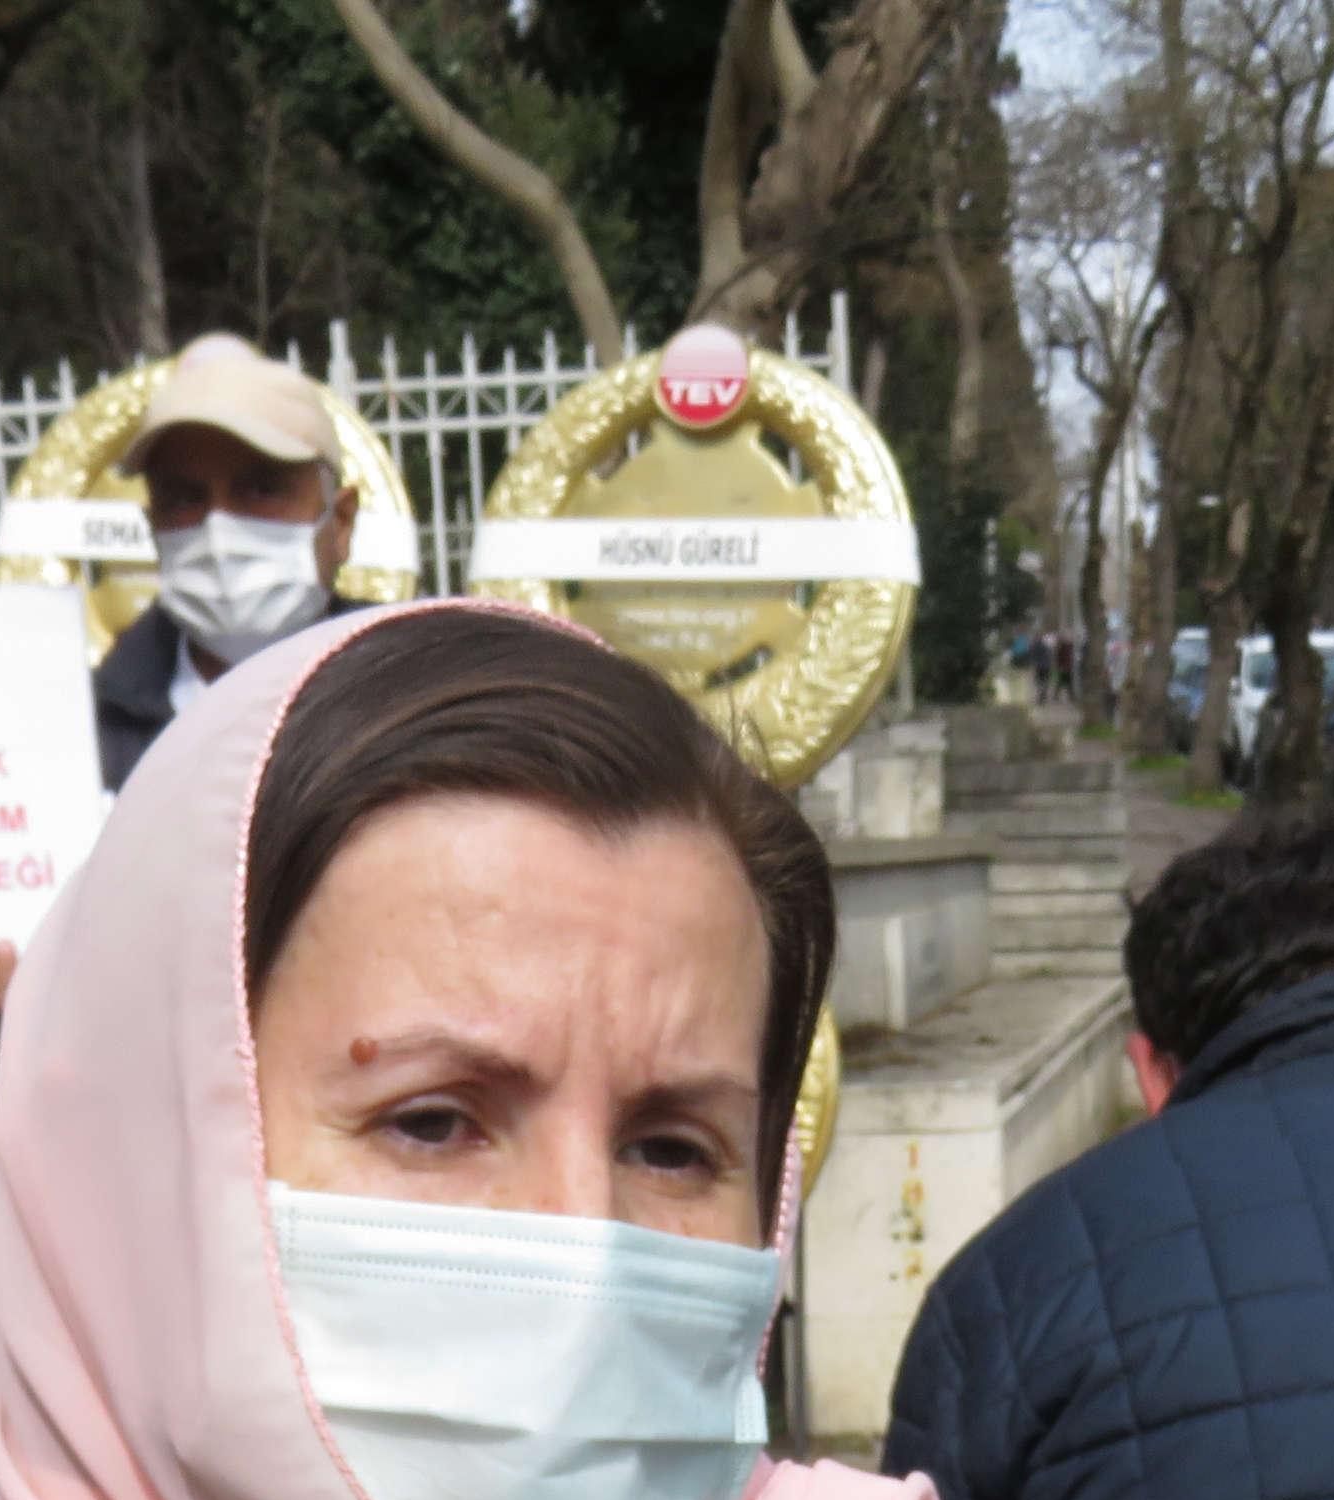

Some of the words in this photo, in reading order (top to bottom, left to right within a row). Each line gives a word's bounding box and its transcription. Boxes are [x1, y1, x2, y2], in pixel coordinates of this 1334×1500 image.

[666, 378, 741, 406] TEV
[599, 528, 671, 566] HÜSNÜ
[679, 528, 759, 566] GÜRELİ
